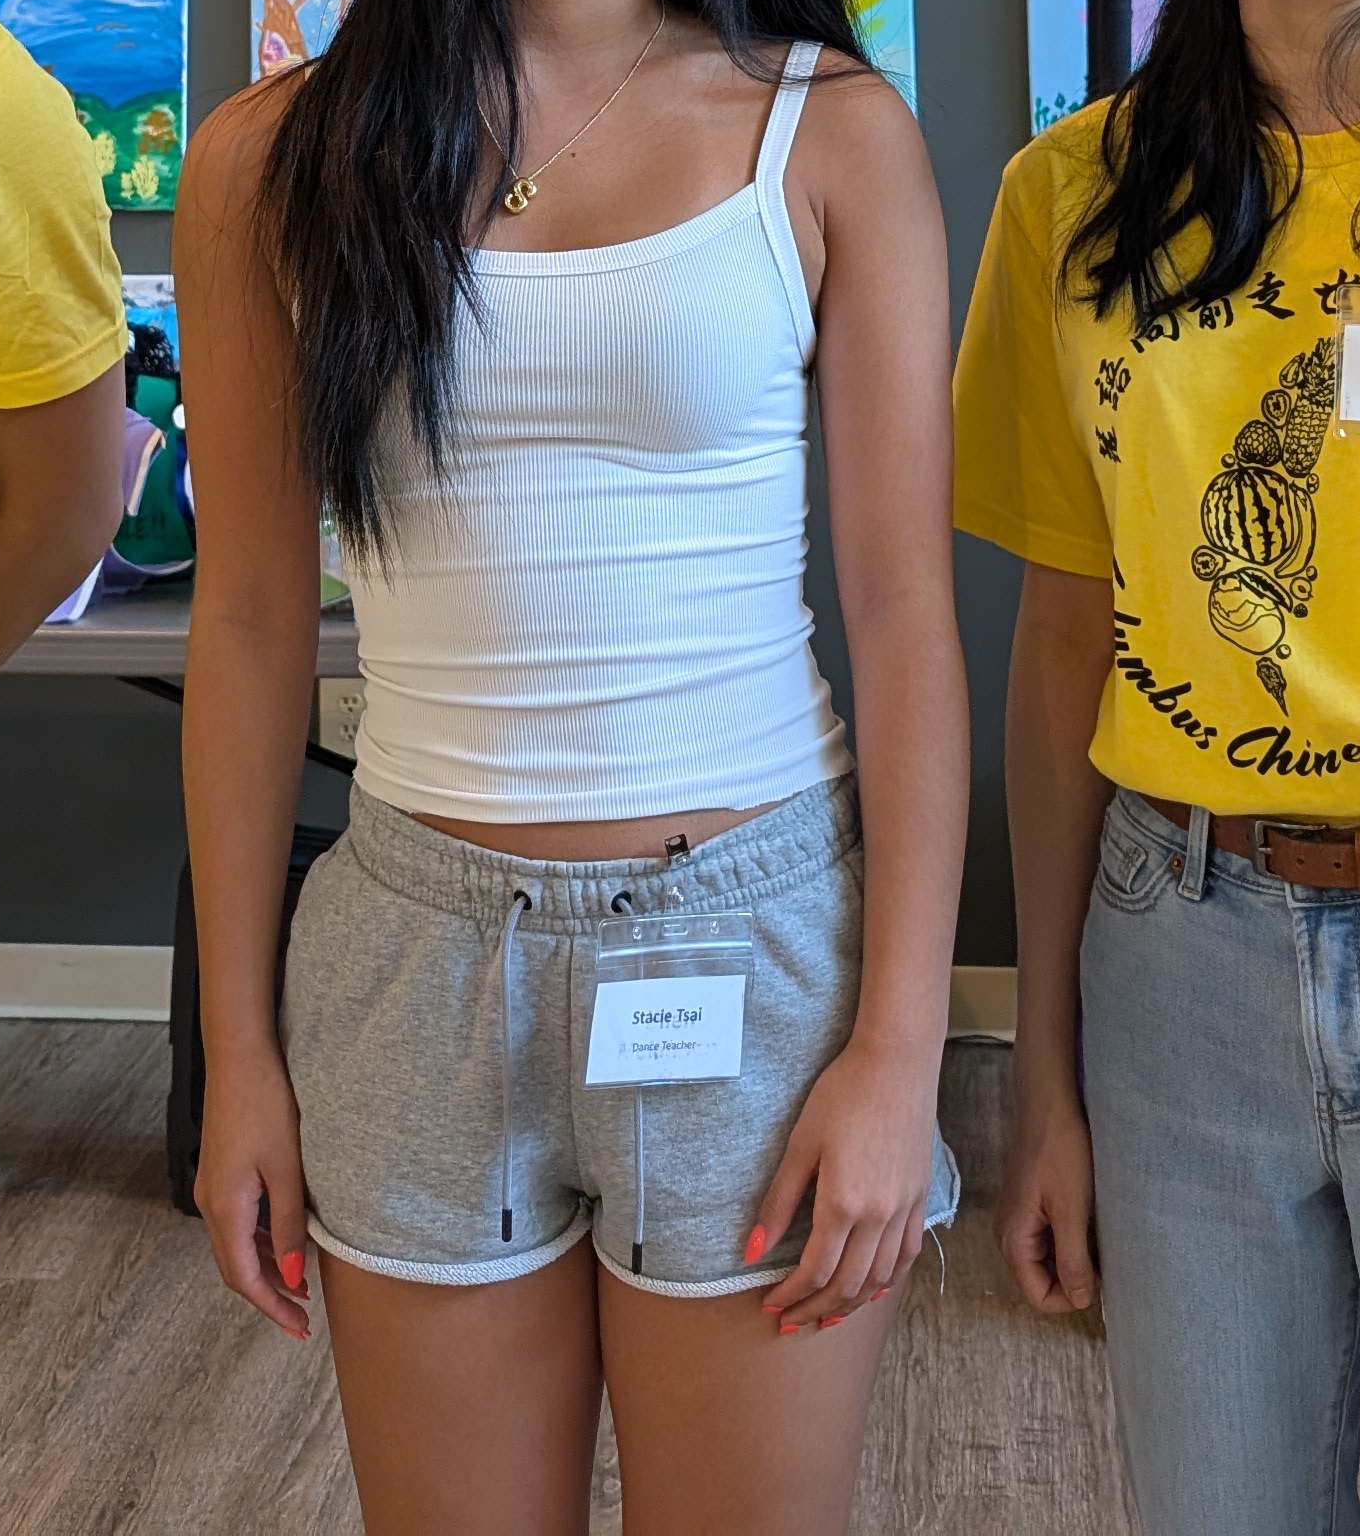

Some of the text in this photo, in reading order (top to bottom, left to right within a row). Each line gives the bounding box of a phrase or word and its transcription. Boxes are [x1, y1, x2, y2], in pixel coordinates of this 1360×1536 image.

[631, 1007, 703, 1025] Stacie Tsai
[632, 1039, 696, 1052] Dance Teacher
